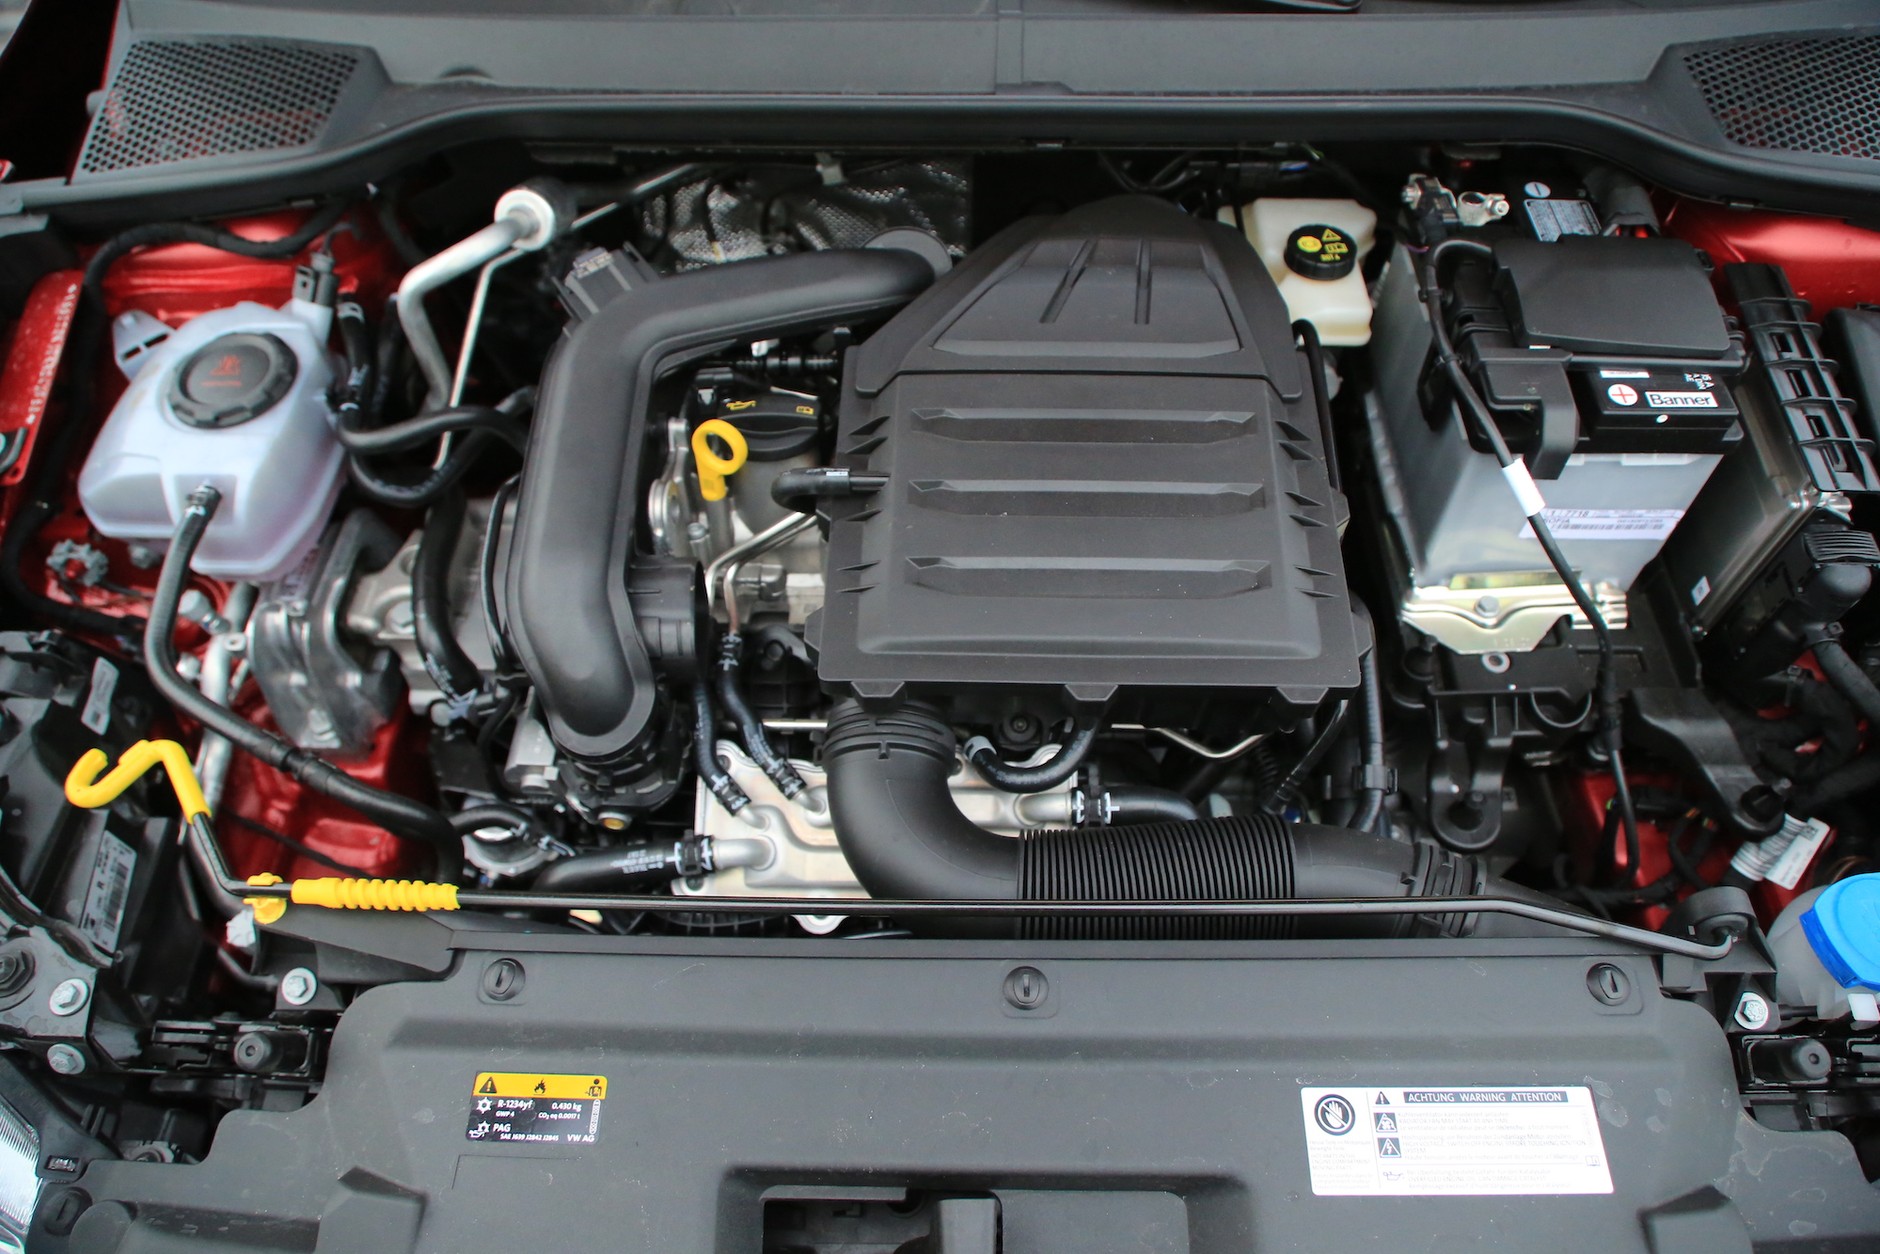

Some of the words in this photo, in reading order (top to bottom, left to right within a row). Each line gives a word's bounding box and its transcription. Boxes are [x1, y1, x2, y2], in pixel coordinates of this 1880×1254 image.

[1650, 393, 1711, 406] Banner
[1408, 1092, 1454, 1102] ACHTUNG
[1460, 1092, 1506, 1102] WARNING
[1511, 1092, 1562, 1102] ATTENTION
[497, 1099, 533, 1111] R-1234yf
[551, 1102, 572, 1110] 0.430
[573, 1102, 582, 1112] kg
[492, 1123, 511, 1132] PAG
[567, 1134, 581, 1142] VW
